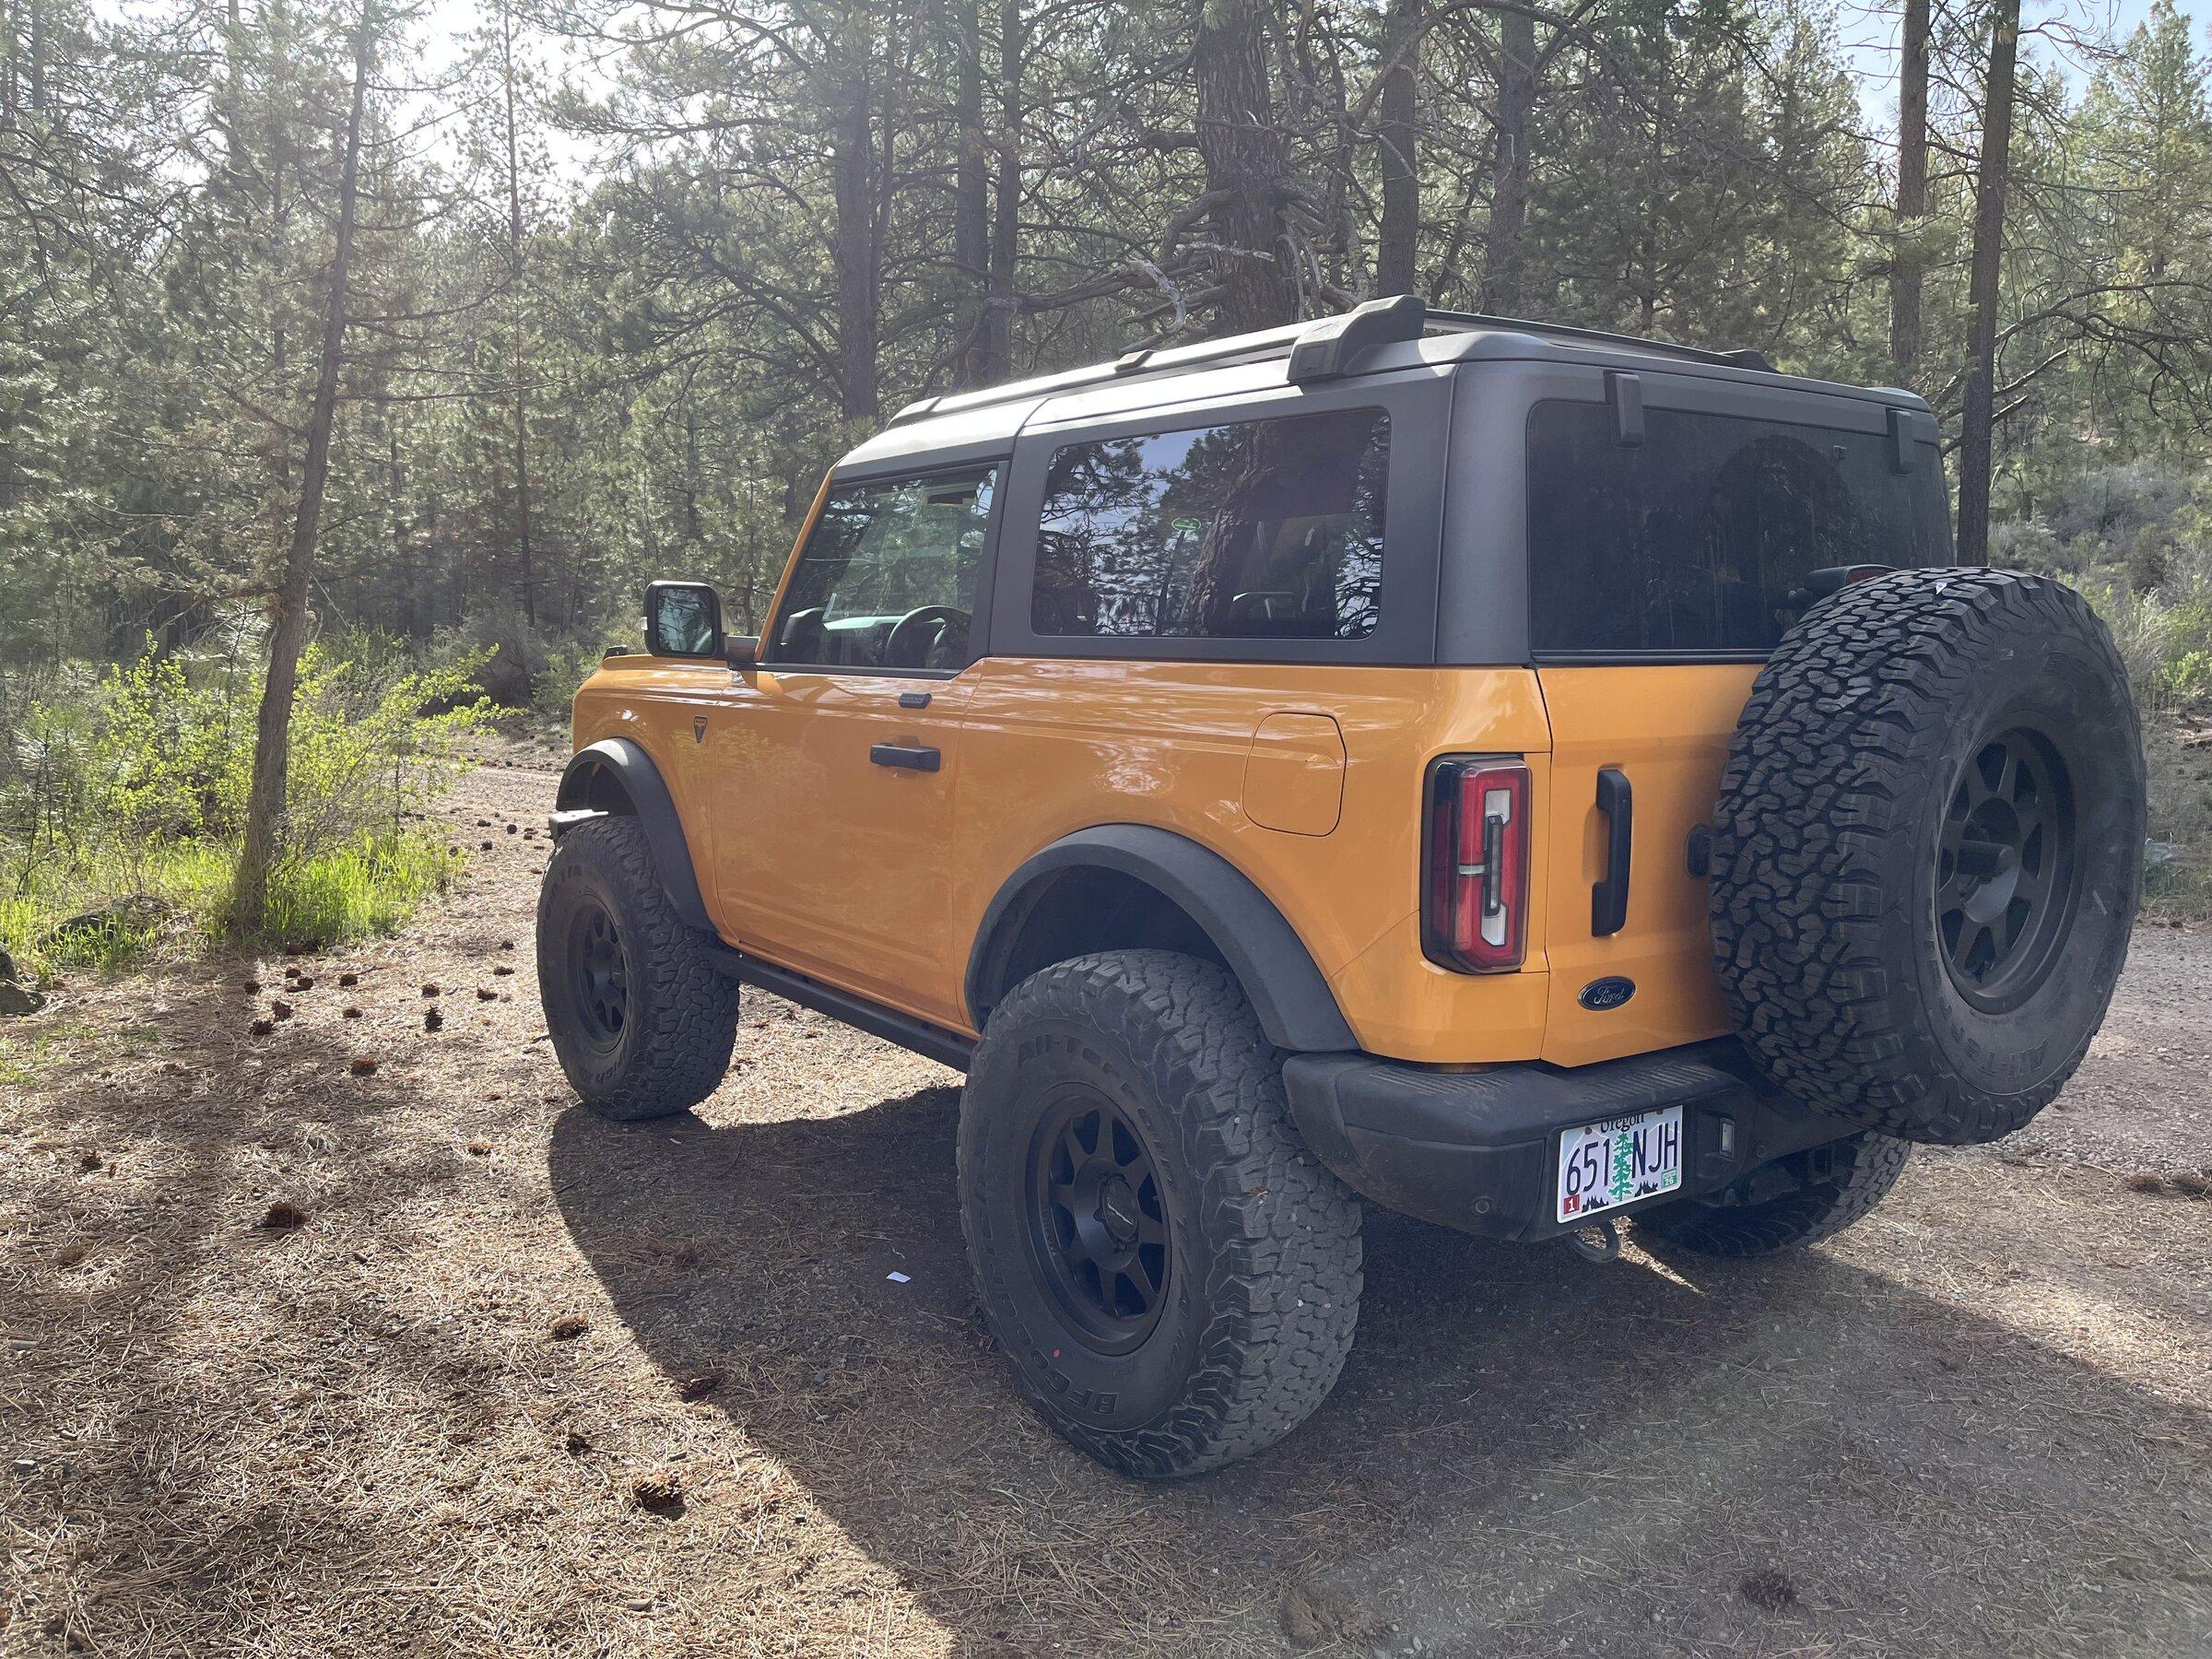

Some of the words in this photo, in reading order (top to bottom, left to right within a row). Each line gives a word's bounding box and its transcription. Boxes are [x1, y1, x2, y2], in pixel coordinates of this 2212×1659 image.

[1593, 986, 1625, 1005] Ford
[1600, 1113, 1645, 1134] Oregon
[1566, 1138, 1611, 1196] 651
[1631, 1121, 1679, 1179] NJH
[1665, 1176, 1675, 1186] 26
[1568, 1199, 1576, 1212] 1
